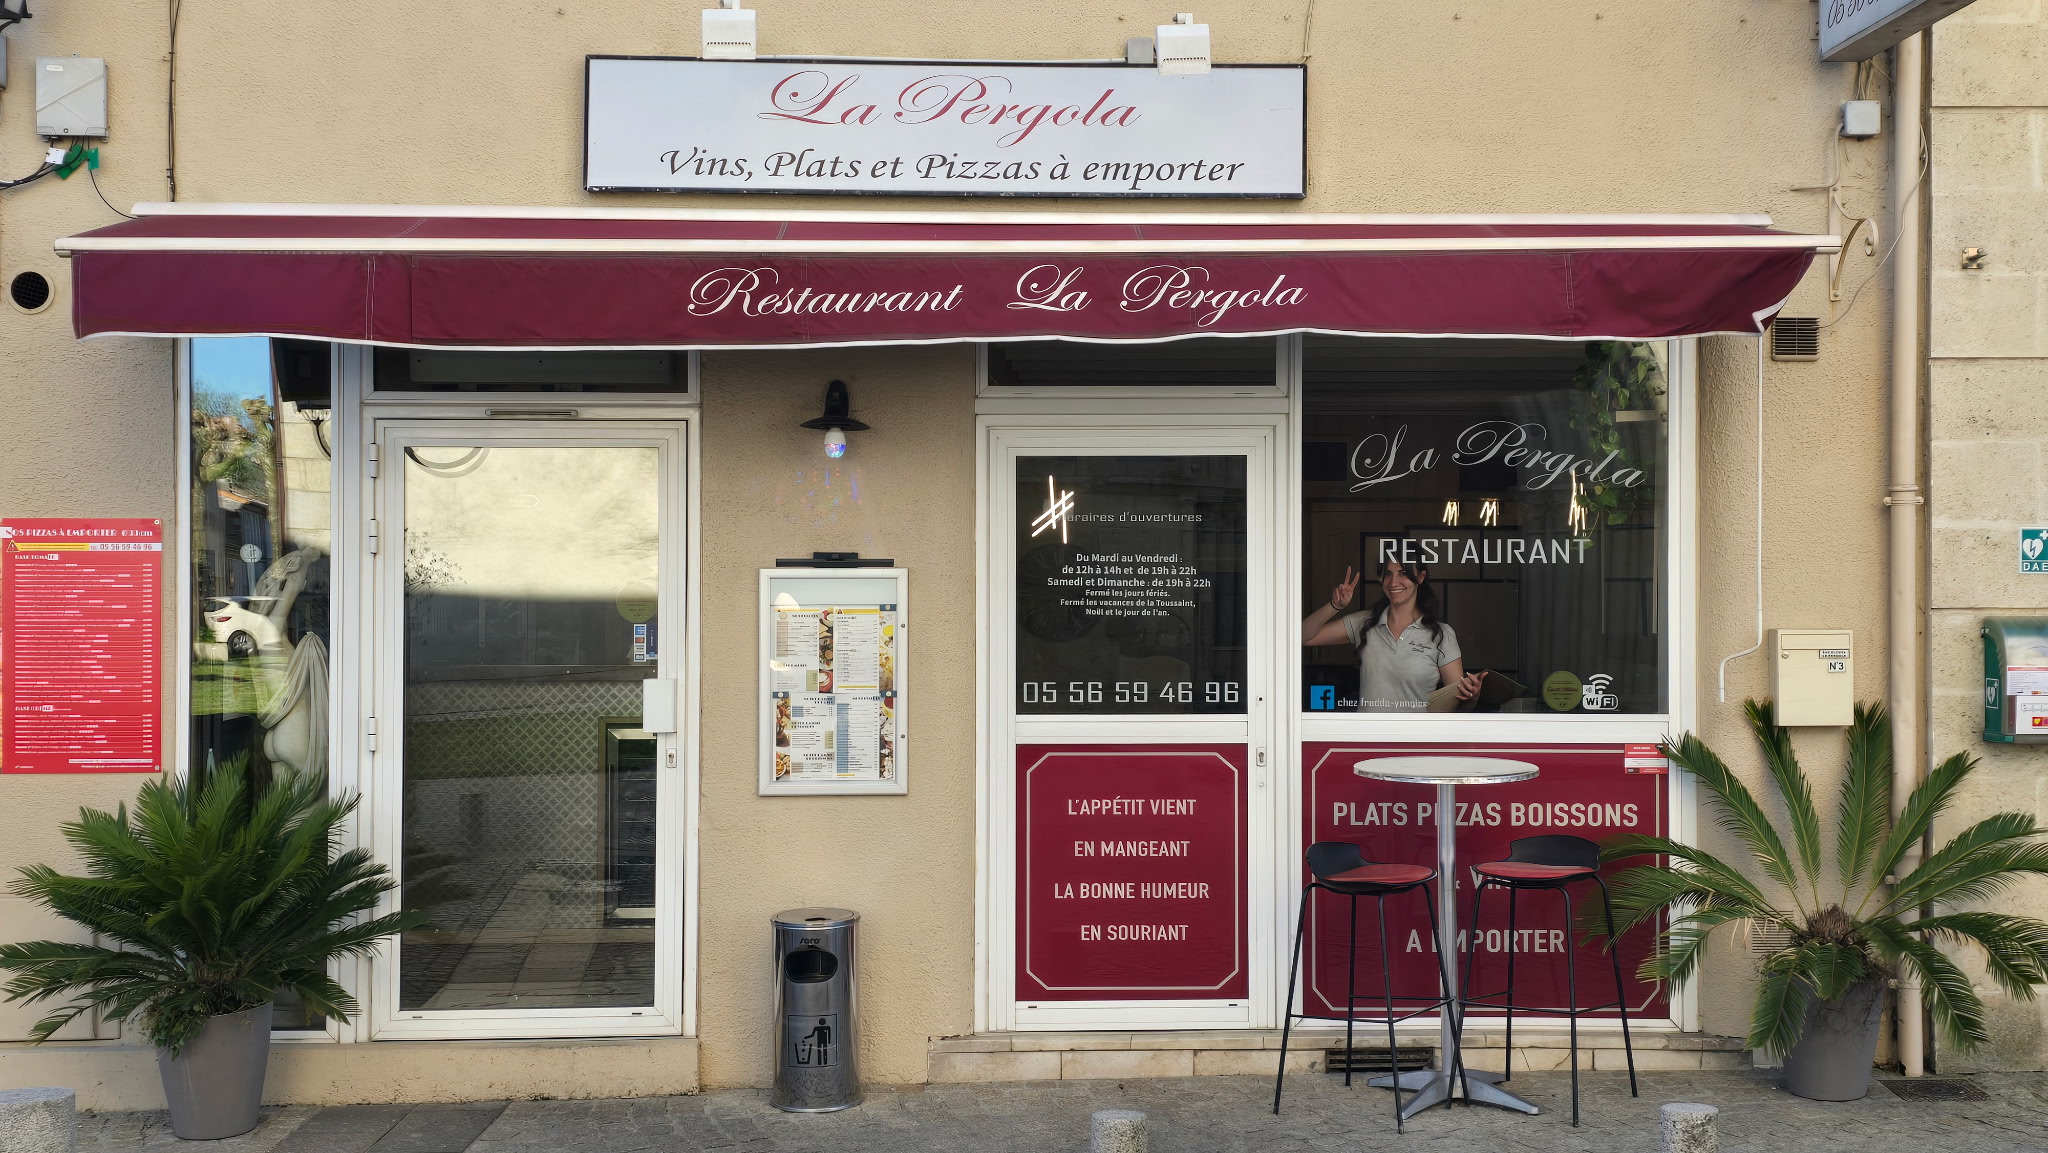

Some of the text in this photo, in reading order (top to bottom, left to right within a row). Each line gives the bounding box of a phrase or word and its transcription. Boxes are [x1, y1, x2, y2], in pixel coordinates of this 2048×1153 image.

[757, 70, 1142, 148] La Pergola
[660, 147, 1245, 191] Vins, Plats et Pizzas à emporter
[687, 264, 1310, 328] Restaurant La Pergola
[1350, 420, 1648, 493] La Pergola
[1119, 511, 1202, 522] d'ouvertures
[99, 543, 109, 551] 05
[1379, 538, 1592, 564] RESTAURANT
[1076, 553, 1090, 563] Du
[1091, 553, 1119, 563] Mardi
[1121, 555, 1133, 563] au
[1135, 553, 1178, 563] Vendredi
[2023, 562, 2048, 571] DAE
[1062, 563, 1197, 576] de 12h à 14h et de 19h à 22h
[1047, 577, 1083, 587] Samedi
[1085, 578, 1095, 587] et
[1097, 577, 1146, 588] Dimanche
[1151, 577, 1164, 588] de
[1166, 577, 1184, 588] 19h
[1185, 577, 1192, 588] à
[1193, 578, 1212, 588] 22h
[1085, 588, 1171, 598] Fermé les jours fériés.
[1060, 597, 1085, 606] Fermé
[1086, 598, 1098, 606] les
[1136, 598, 1146, 607] de
[1147, 598, 1155, 607] la
[1156, 599, 1196, 608] Toussaint,
[1085, 608, 1104, 616] Noël
[1105, 608, 1114, 616] et
[1115, 608, 1123, 617] le
[1123, 608, 1140, 618] jour
[1141, 608, 1151, 617] de
[1023, 681, 1239, 703] 05 56 59 46 96
[1337, 697, 1358, 707] chez
[1068, 795, 1197, 816] L'APPÉTIT VIENT
[1333, 802, 1639, 827] PLATS PIZAS BOISSONS
[1074, 840, 1190, 857] EN MANGEANT
[1054, 882, 1210, 899] LA BONNE HUMEUR
[1080, 924, 1189, 941] EN SOURIANT
[1405, 929, 1423, 953] A
